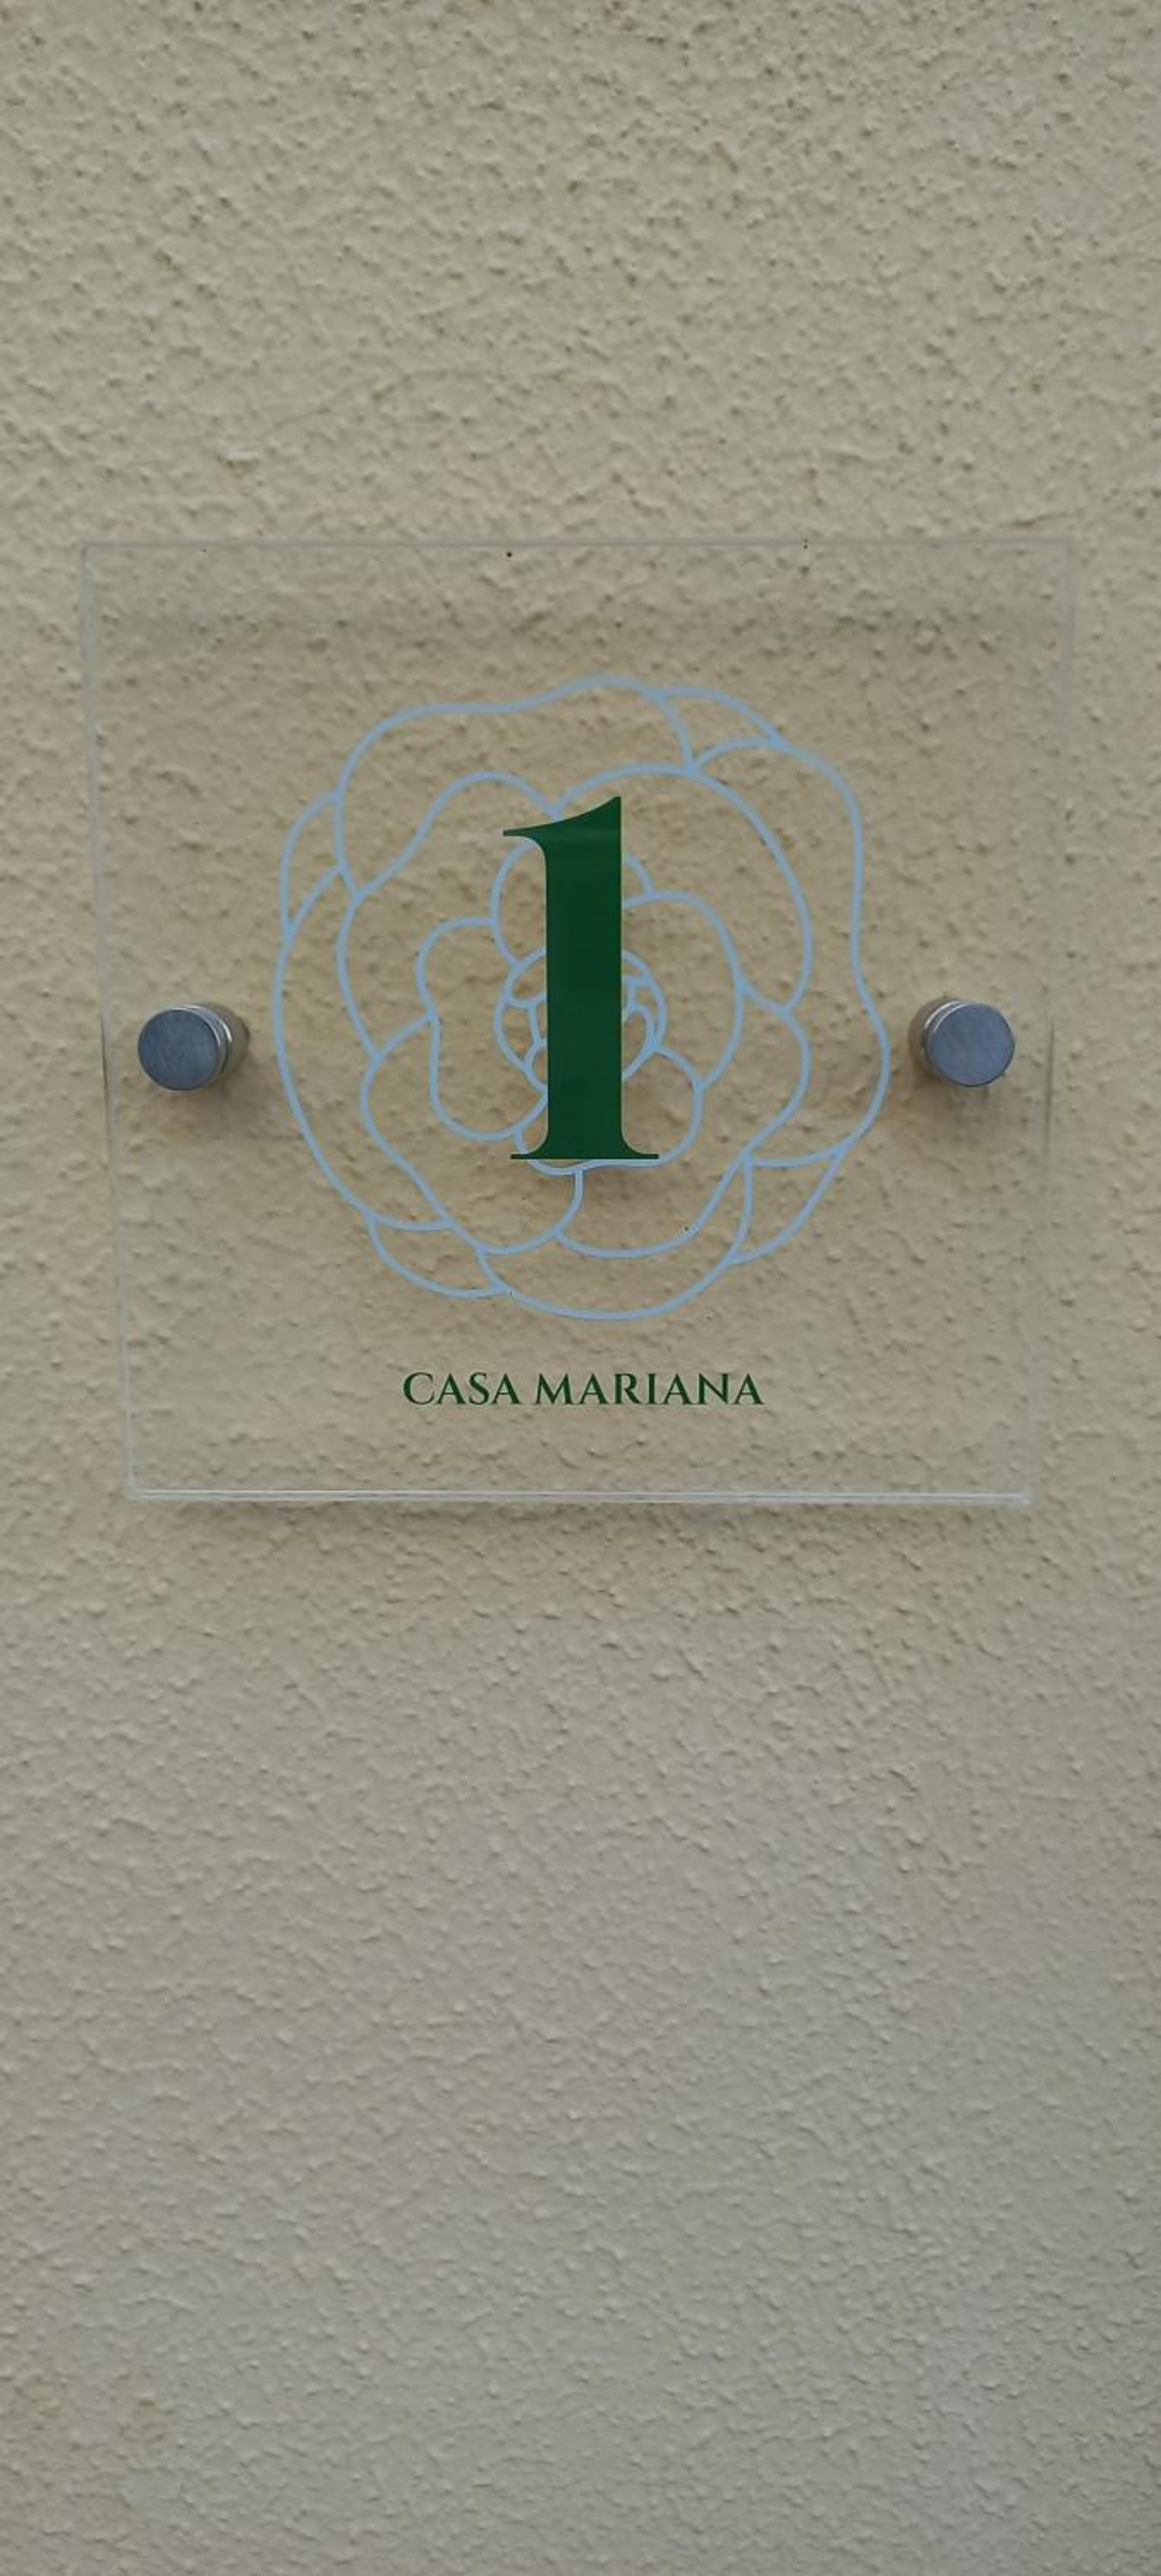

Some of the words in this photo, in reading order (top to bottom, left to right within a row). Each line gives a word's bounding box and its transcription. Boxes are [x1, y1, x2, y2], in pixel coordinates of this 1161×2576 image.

[502, 796, 660, 1162] 1
[402, 1372, 521, 1406] CASA
[534, 1372, 764, 1406] MARIANA
